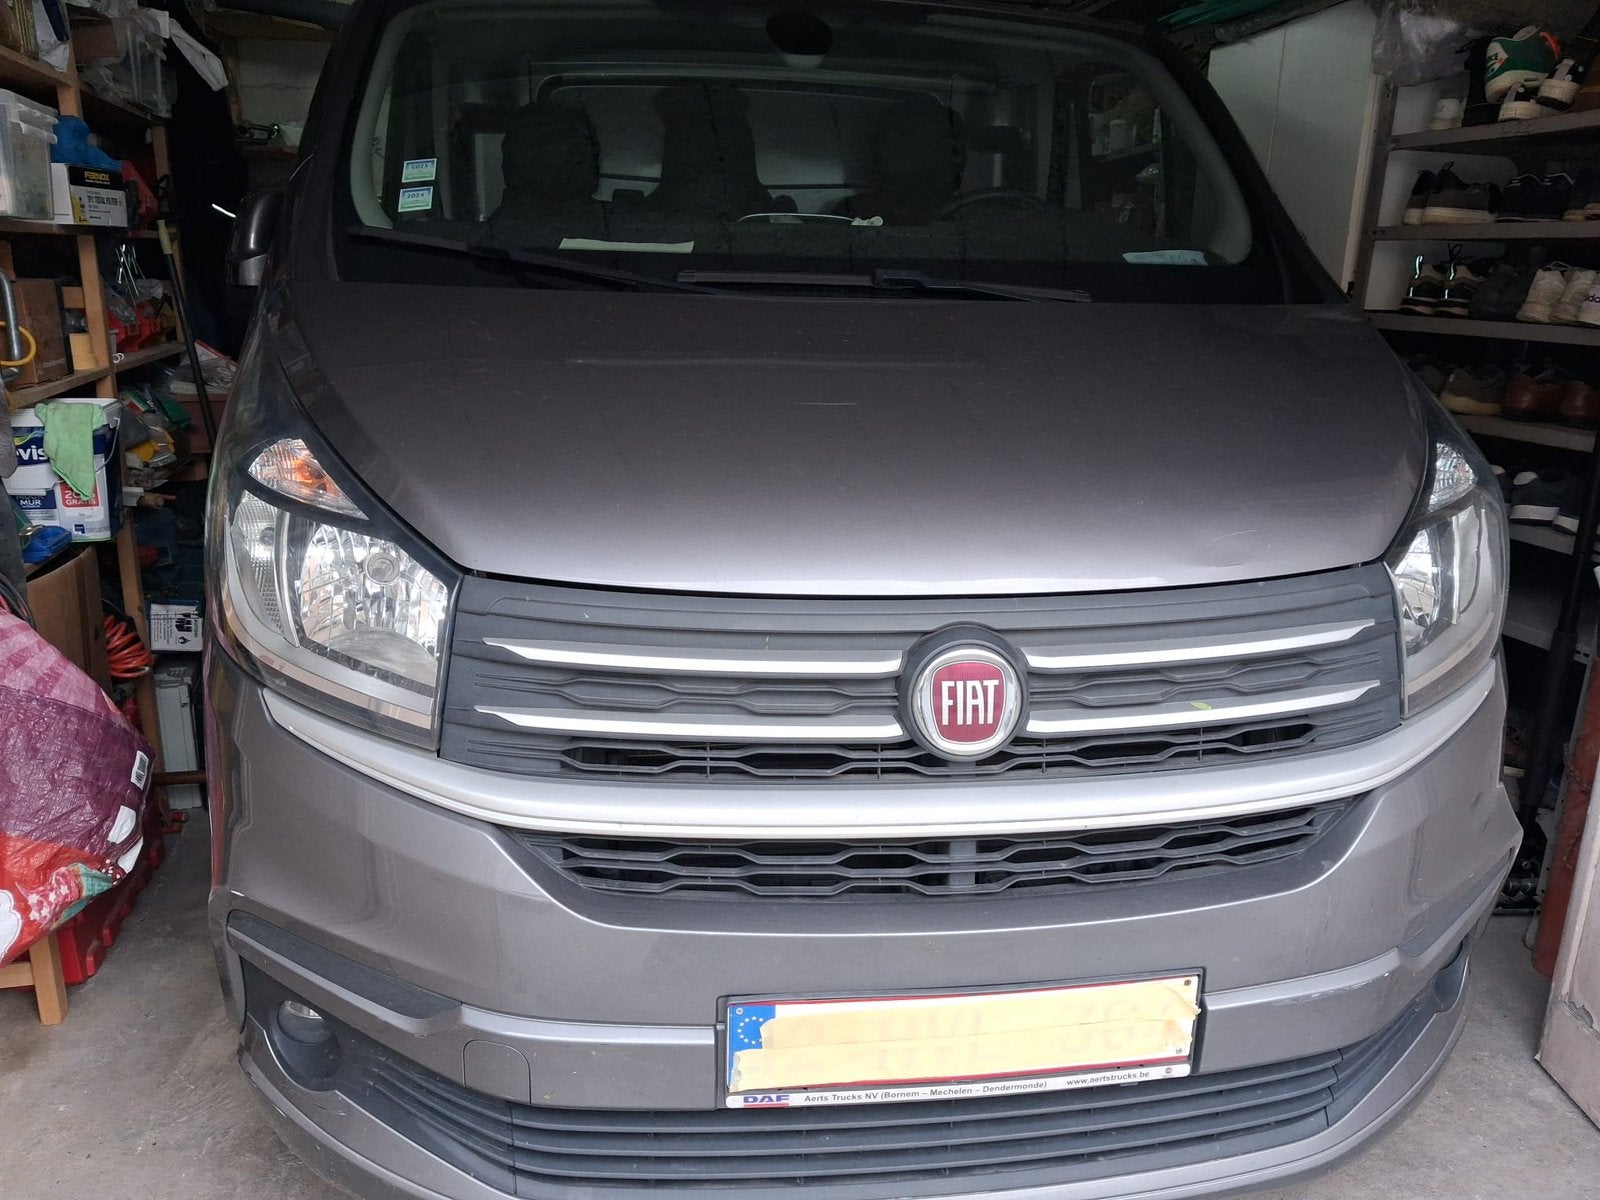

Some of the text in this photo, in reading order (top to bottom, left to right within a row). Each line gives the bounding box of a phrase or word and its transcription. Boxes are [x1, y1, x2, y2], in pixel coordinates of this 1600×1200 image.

[16, 445, 49, 461] vis
[941, 680, 999, 726] FIAT
[743, 1094, 790, 1104] DAF
[804, 1094, 829, 1103] Aerts
[831, 1093, 862, 1102] Trucks
[865, 1092, 878, 1100] NV
[880, 1091, 920, 1100] (Bornem
[930, 1087, 973, 1097] Mechelen
[982, 1081, 1048, 1093] Dendermonde)
[1066, 1071, 1150, 1086] www.aertstrucks.be
